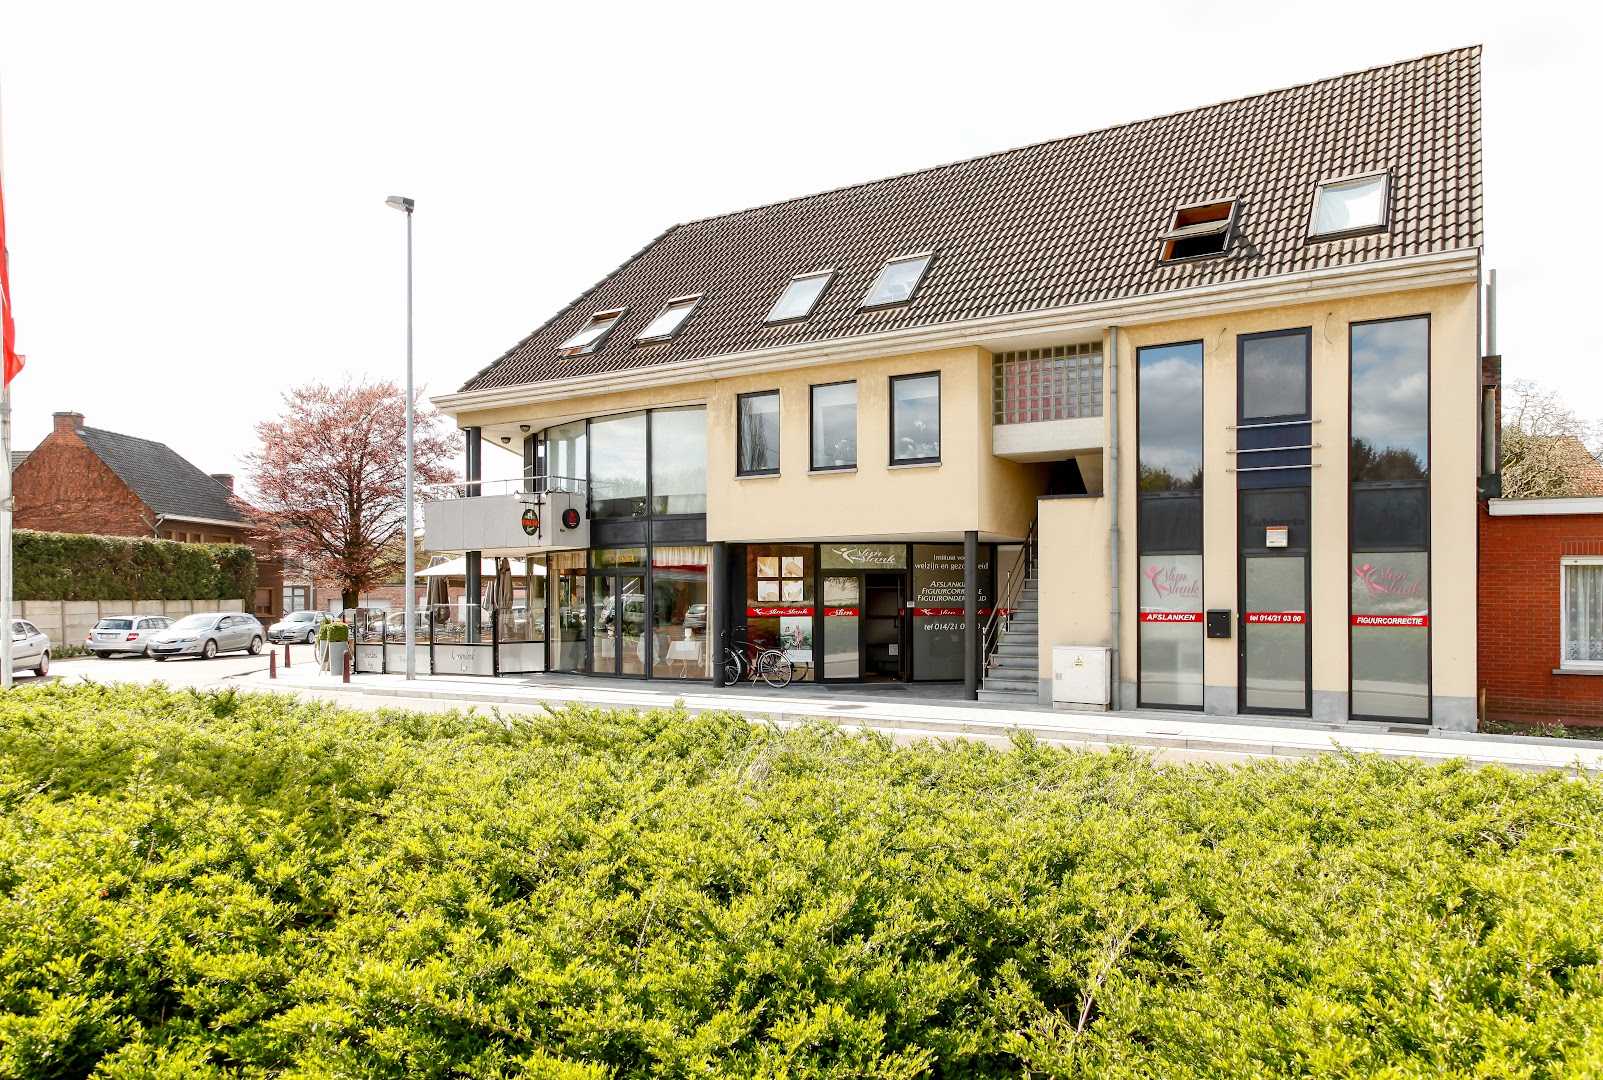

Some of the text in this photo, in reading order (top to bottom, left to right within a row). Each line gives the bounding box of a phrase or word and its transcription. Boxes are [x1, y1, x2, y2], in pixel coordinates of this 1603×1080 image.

[522, 518, 538, 526] PALM
[914, 562, 939, 570] welzijn
[950, 562, 989, 571] gezoeid
[829, 608, 854, 617] Slim
[1259, 614, 1281, 622] 014/21
[1356, 616, 1424, 625] FIGUURCORRECTIE
[934, 623, 958, 631] 014/21
